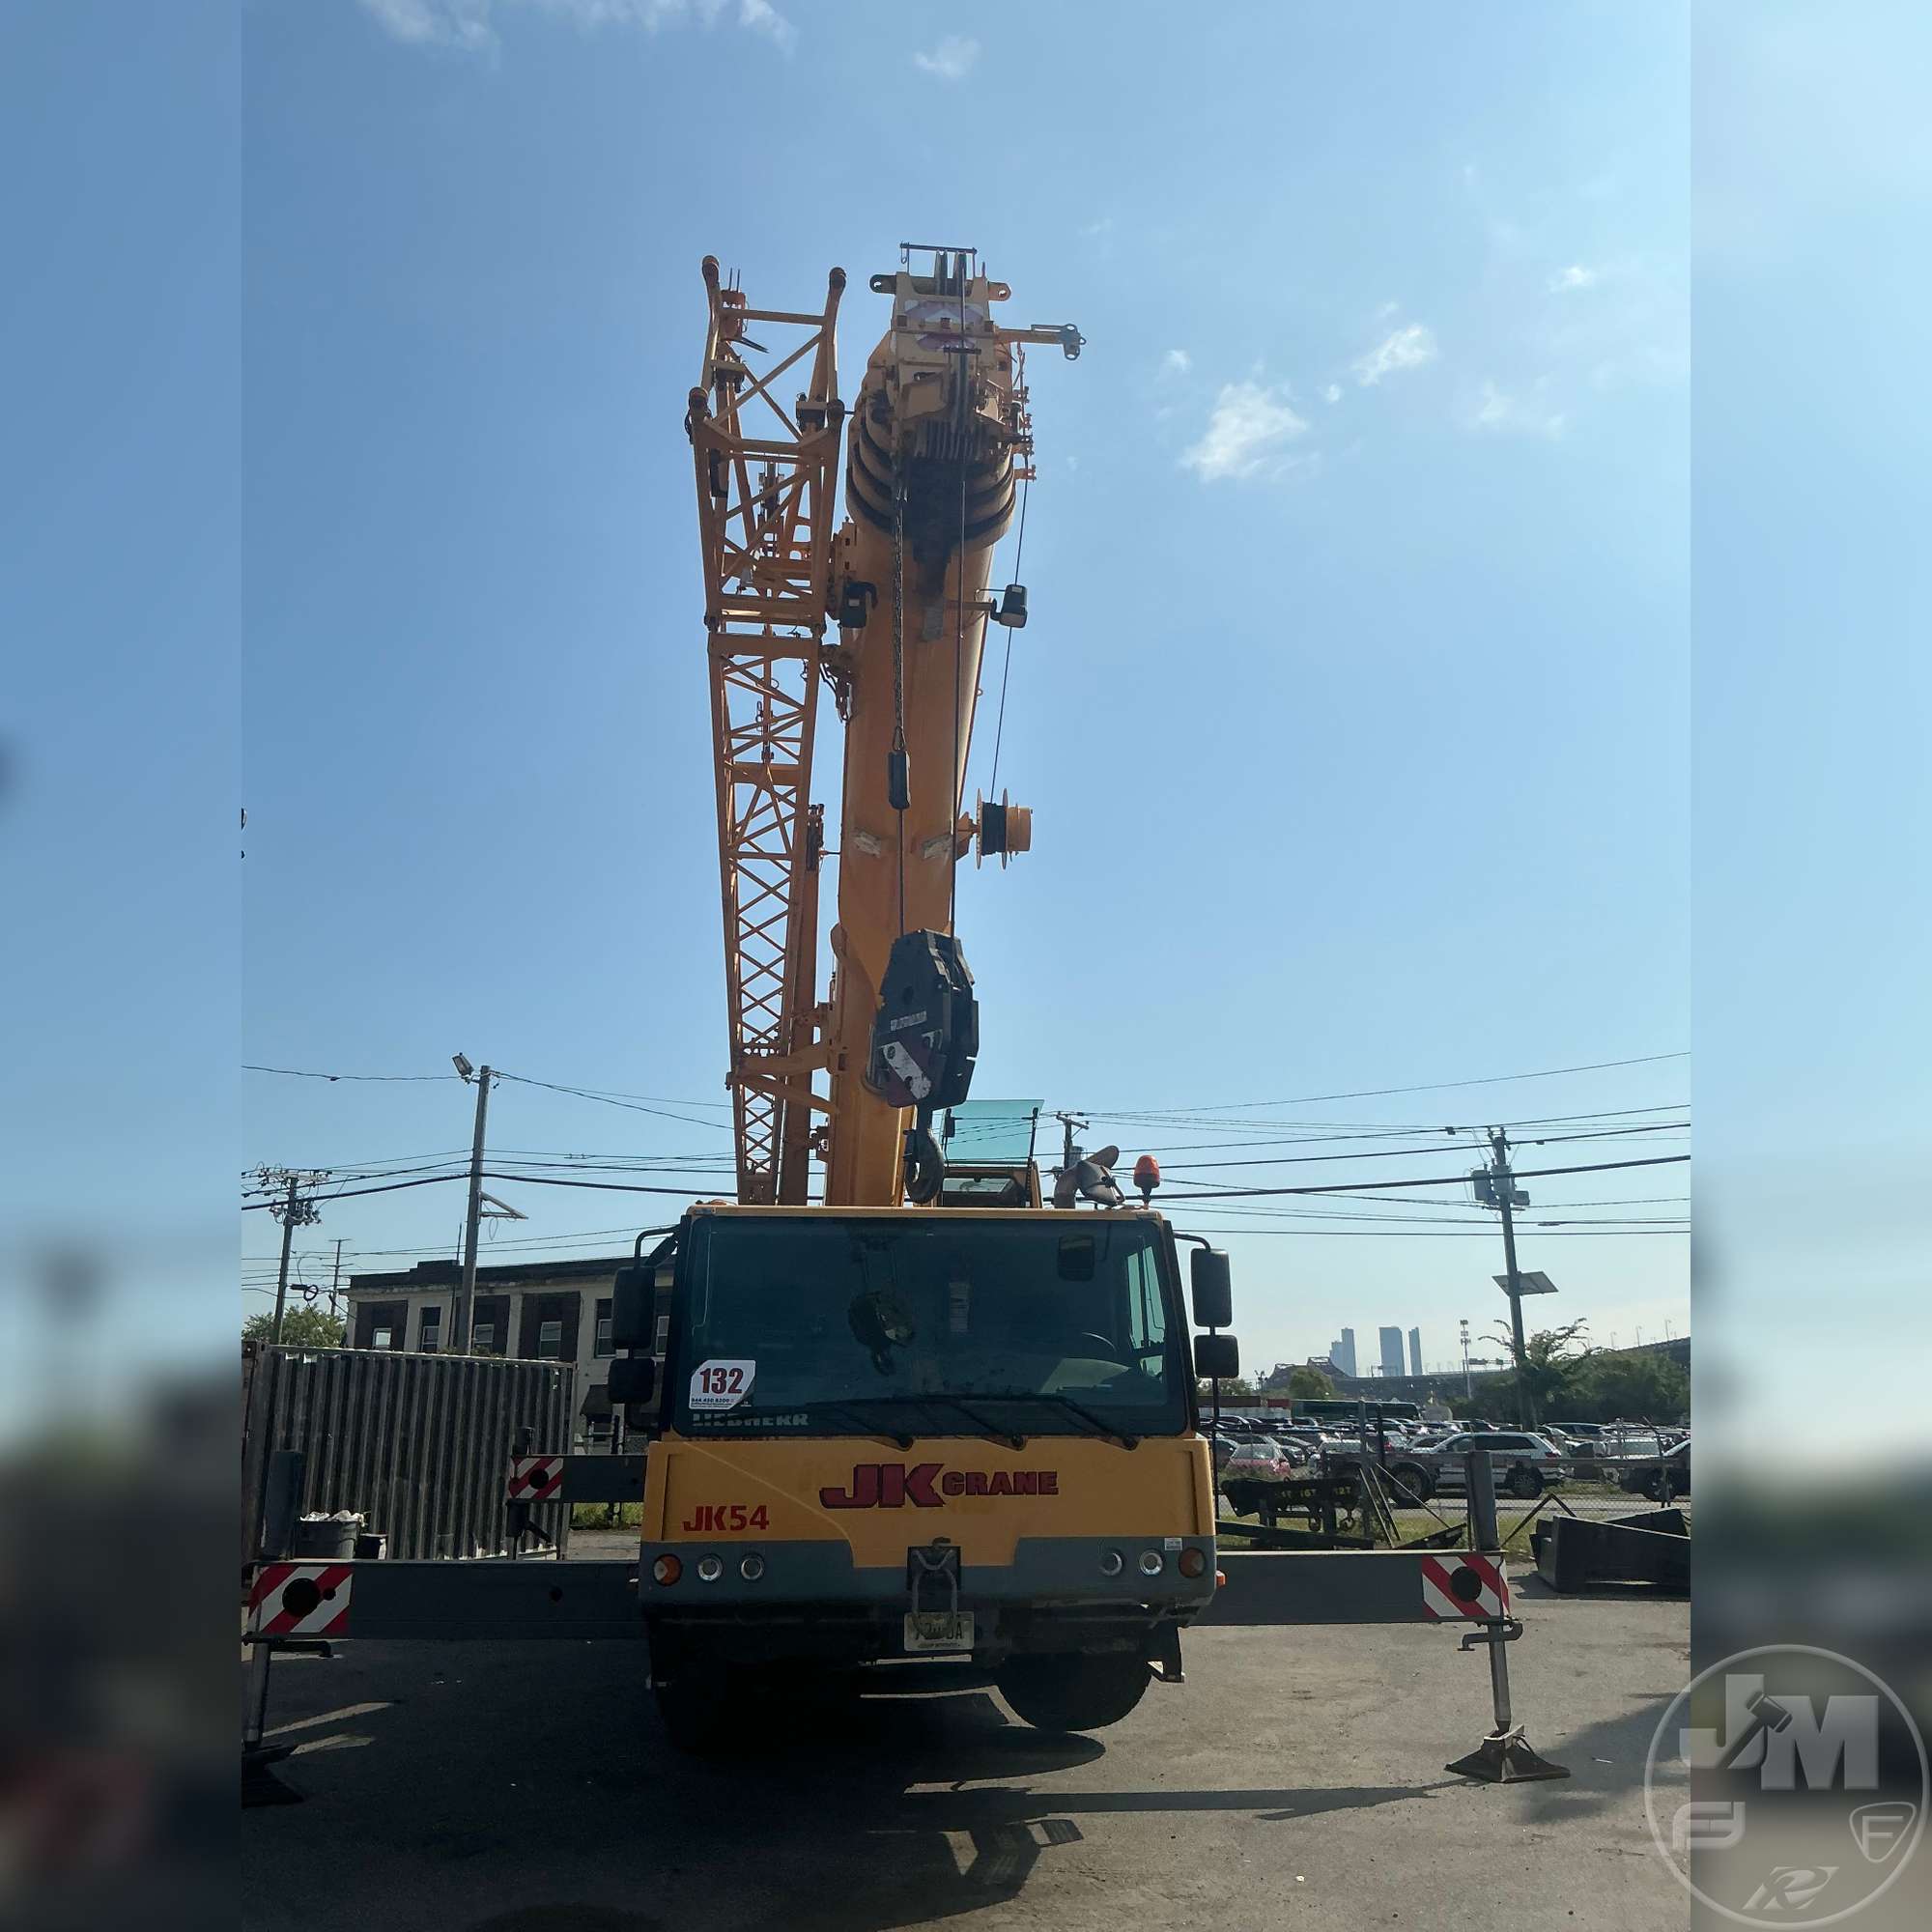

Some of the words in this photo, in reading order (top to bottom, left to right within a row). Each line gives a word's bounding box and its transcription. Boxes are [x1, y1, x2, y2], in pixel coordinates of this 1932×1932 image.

[699, 1368, 744, 1394] 132
[819, 1463, 945, 1509] JK
[942, 1470, 1060, 1496] CRANE
[683, 1505, 769, 1532] JK54
